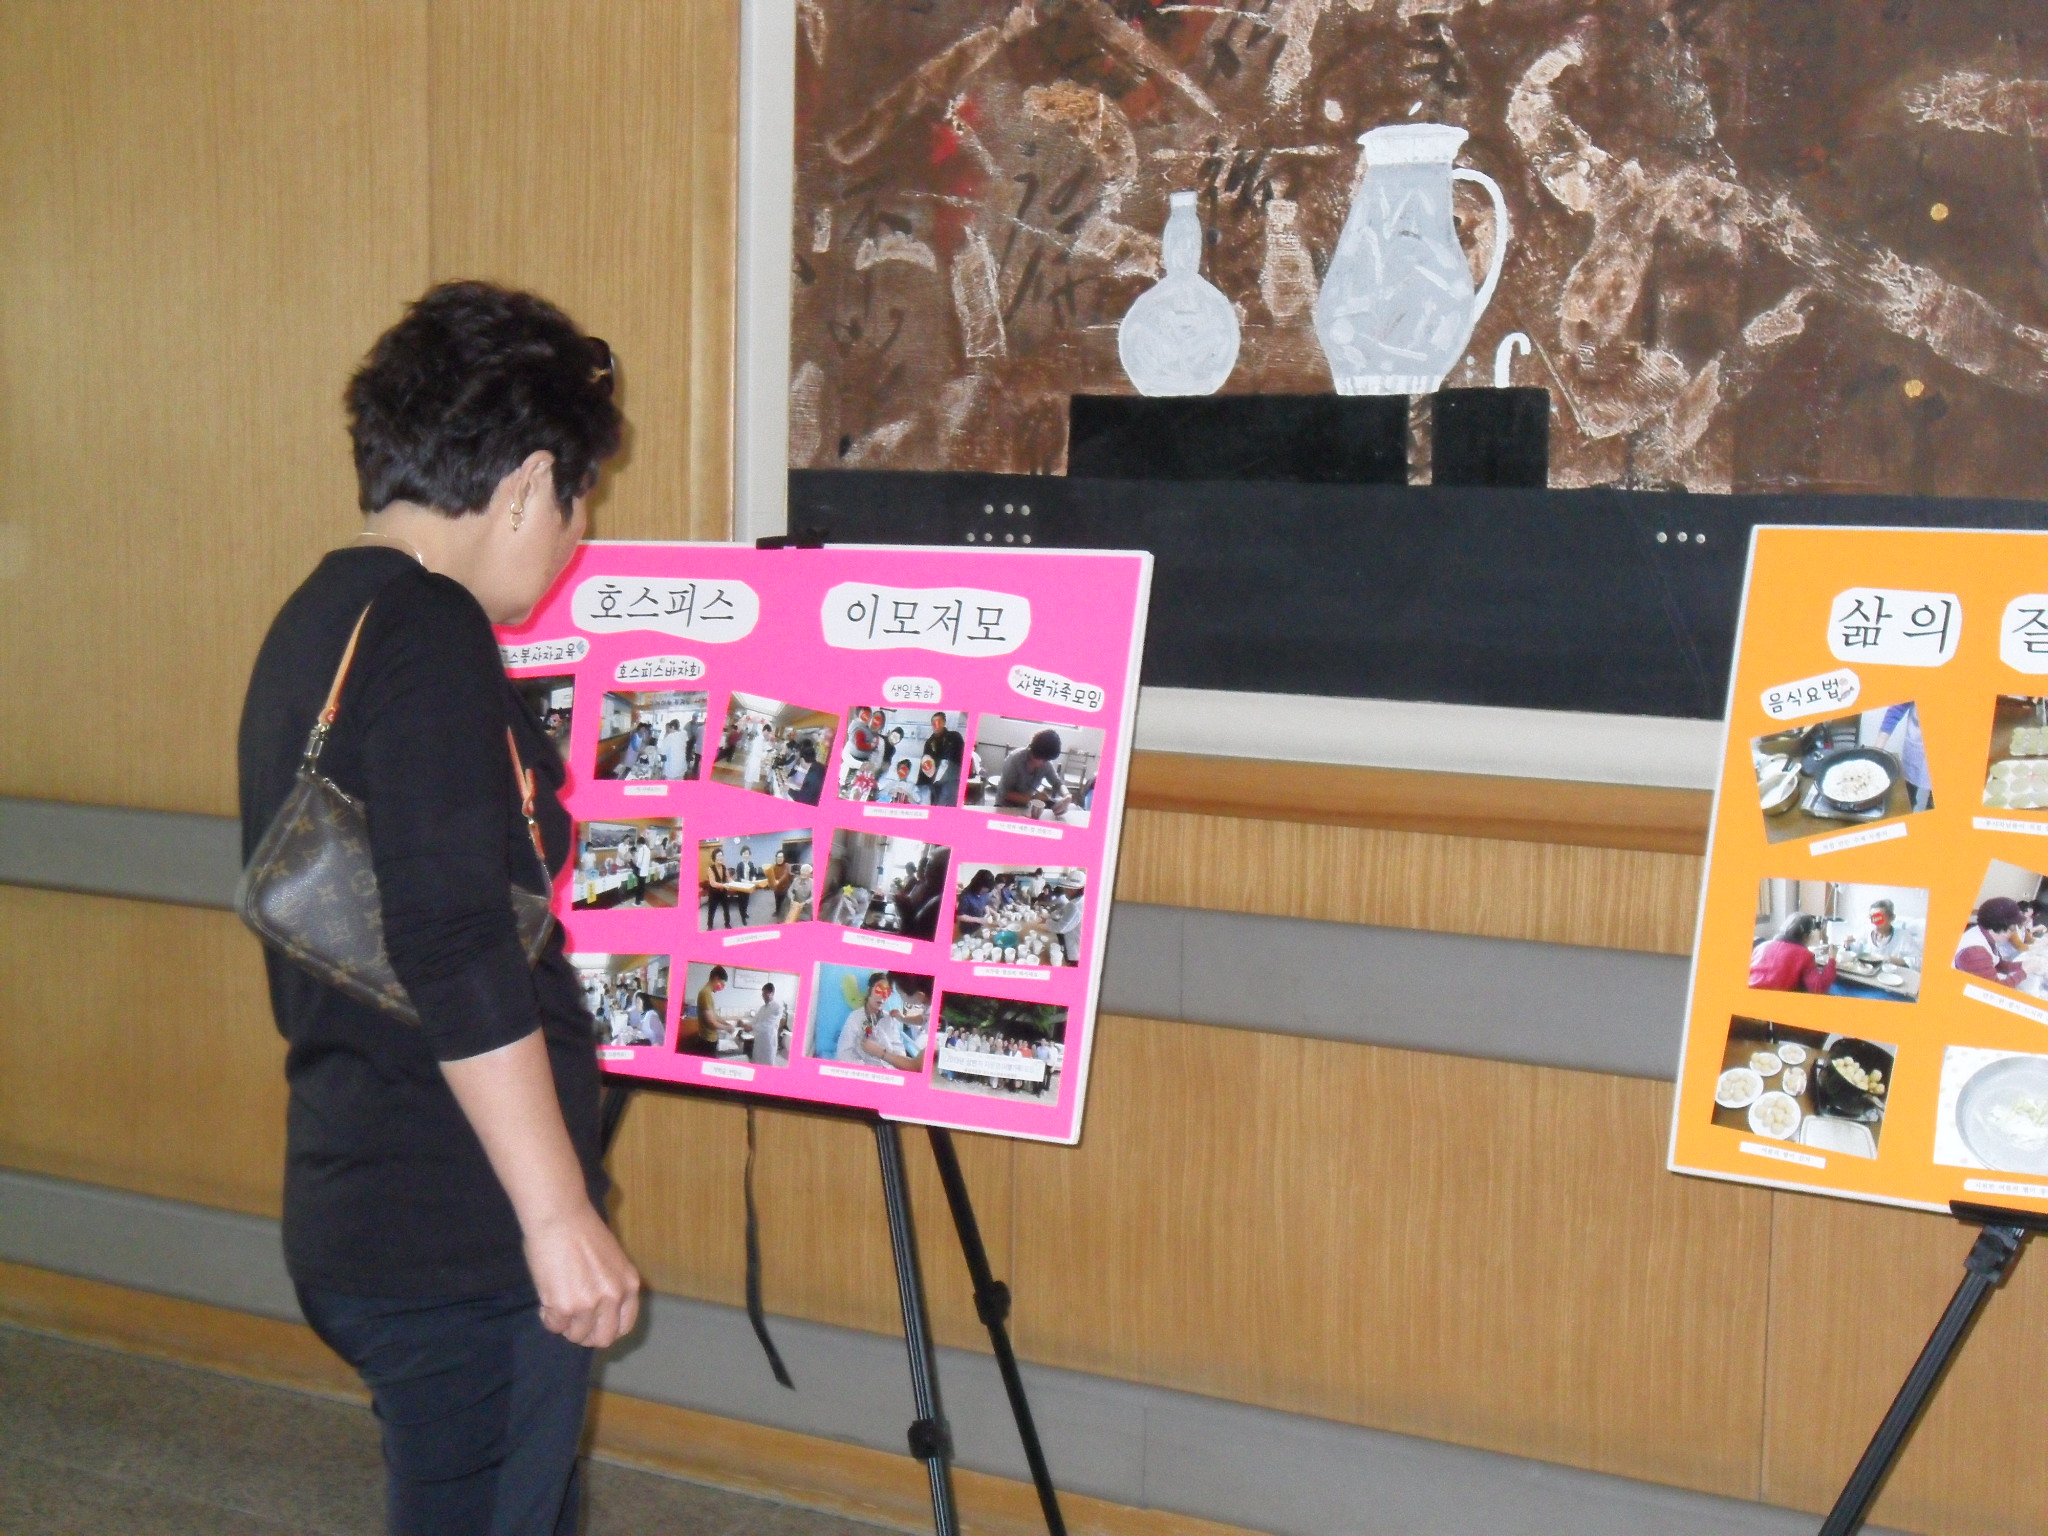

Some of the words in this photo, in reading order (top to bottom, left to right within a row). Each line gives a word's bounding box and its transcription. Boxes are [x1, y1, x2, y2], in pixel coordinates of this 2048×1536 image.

[590, 582, 735, 628] 호스피스
[846, 593, 1007, 647] 이모저모
[501, 642, 576, 664] 스봉사자교육
[617, 660, 700, 680] 호스피스바자회
[891, 684, 935, 699] 생일축하
[1016, 675, 1102, 709] 사별가족모임
[1767, 677, 1842, 714] 음식요법
